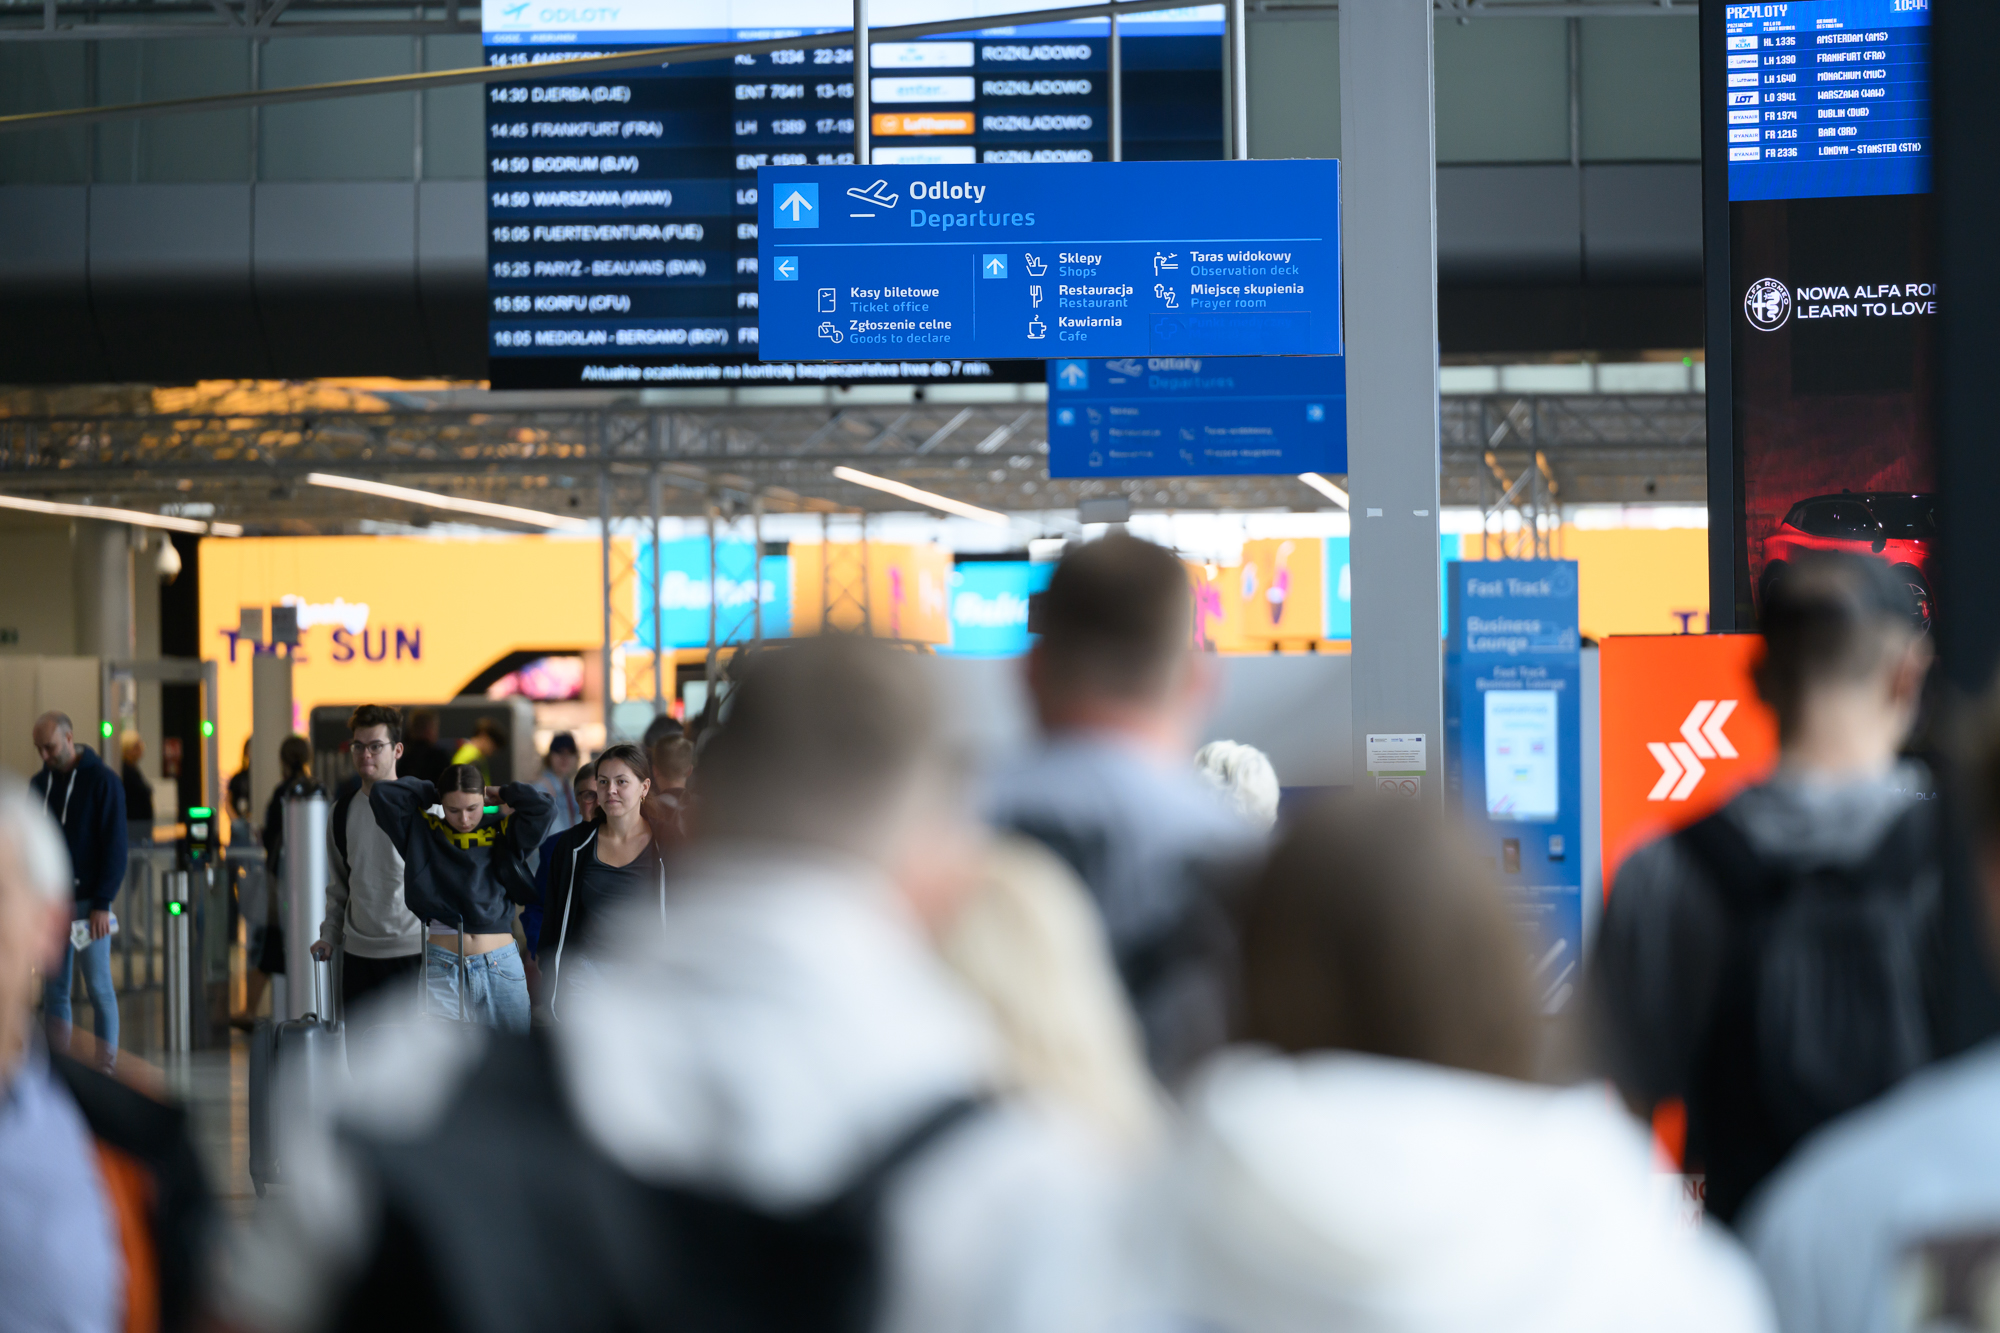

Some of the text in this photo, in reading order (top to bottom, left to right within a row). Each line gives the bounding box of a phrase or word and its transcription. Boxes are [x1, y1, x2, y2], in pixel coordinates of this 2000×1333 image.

[539, 8, 621, 23] ODLOTY
[1764, 37, 1795, 46] KL 1335
[1764, 55, 1796, 65] LH 1390
[1765, 74, 1796, 83] LH 1640
[531, 86, 591, 102] DJERBA
[591, 85, 631, 104] (DJE)
[1735, 95, 1754, 103] LOT
[1765, 93, 1796, 102] LO 3941
[1765, 111, 1797, 120] FR 1974
[490, 120, 663, 139] 14:45 FRANKFURT (FRA)
[735, 120, 758, 136] LH
[1765, 129, 1797, 139] FR 1216
[1766, 148, 1797, 157] FR 2336
[532, 156, 600, 173] BODRUM
[600, 155, 639, 174] (BJV)
[533, 191, 622, 207] WARSZAWA
[622, 189, 672, 208] (WAW)
[910, 181, 986, 203] Odloty
[911, 210, 1035, 231] Departures
[533, 224, 662, 242] FUERTEVENTURA
[662, 223, 704, 242] (FUE)
[1059, 252, 1102, 266] Sklepy
[1190, 251, 1291, 263] Taras widokowy
[591, 259, 666, 277] BEAUVAIS
[666, 258, 706, 278] (BVA)
[1059, 266, 1097, 279] Shops
[1191, 265, 1298, 276] Observation deck
[851, 287, 939, 300] Kasy biletowe
[1059, 285, 1133, 298] Restauracja
[1190, 283, 1303, 297] Miejsce skupienia
[1745, 279, 1790, 308] ALFA ROMEO
[1797, 287, 1849, 300] NOWA
[1854, 285, 1901, 298] ALFA
[534, 295, 588, 312] KORFU
[588, 294, 631, 314] (CFU)
[850, 302, 928, 312] Ticket office
[1059, 298, 1128, 308] Restaurant
[1190, 298, 1231, 310] Prayer
[1798, 304, 1857, 318] LEARN
[1862, 303, 1886, 316] TO
[850, 319, 951, 332] Zgłoszenie celne
[1059, 316, 1122, 327] Kawiarnia
[535, 330, 607, 346] MEDIOLAN
[615, 329, 687, 345] BERGAMO
[850, 332, 951, 343] Goods to declare
[1059, 331, 1087, 341] Cafe
[581, 365, 641, 381] Aktualnie
[642, 364, 722, 381] oczekiwanie
[722, 365, 742, 380] na
[1467, 577, 1551, 597] Fast Track
[1467, 616, 1541, 634] Business
[332, 628, 420, 662] SUN
